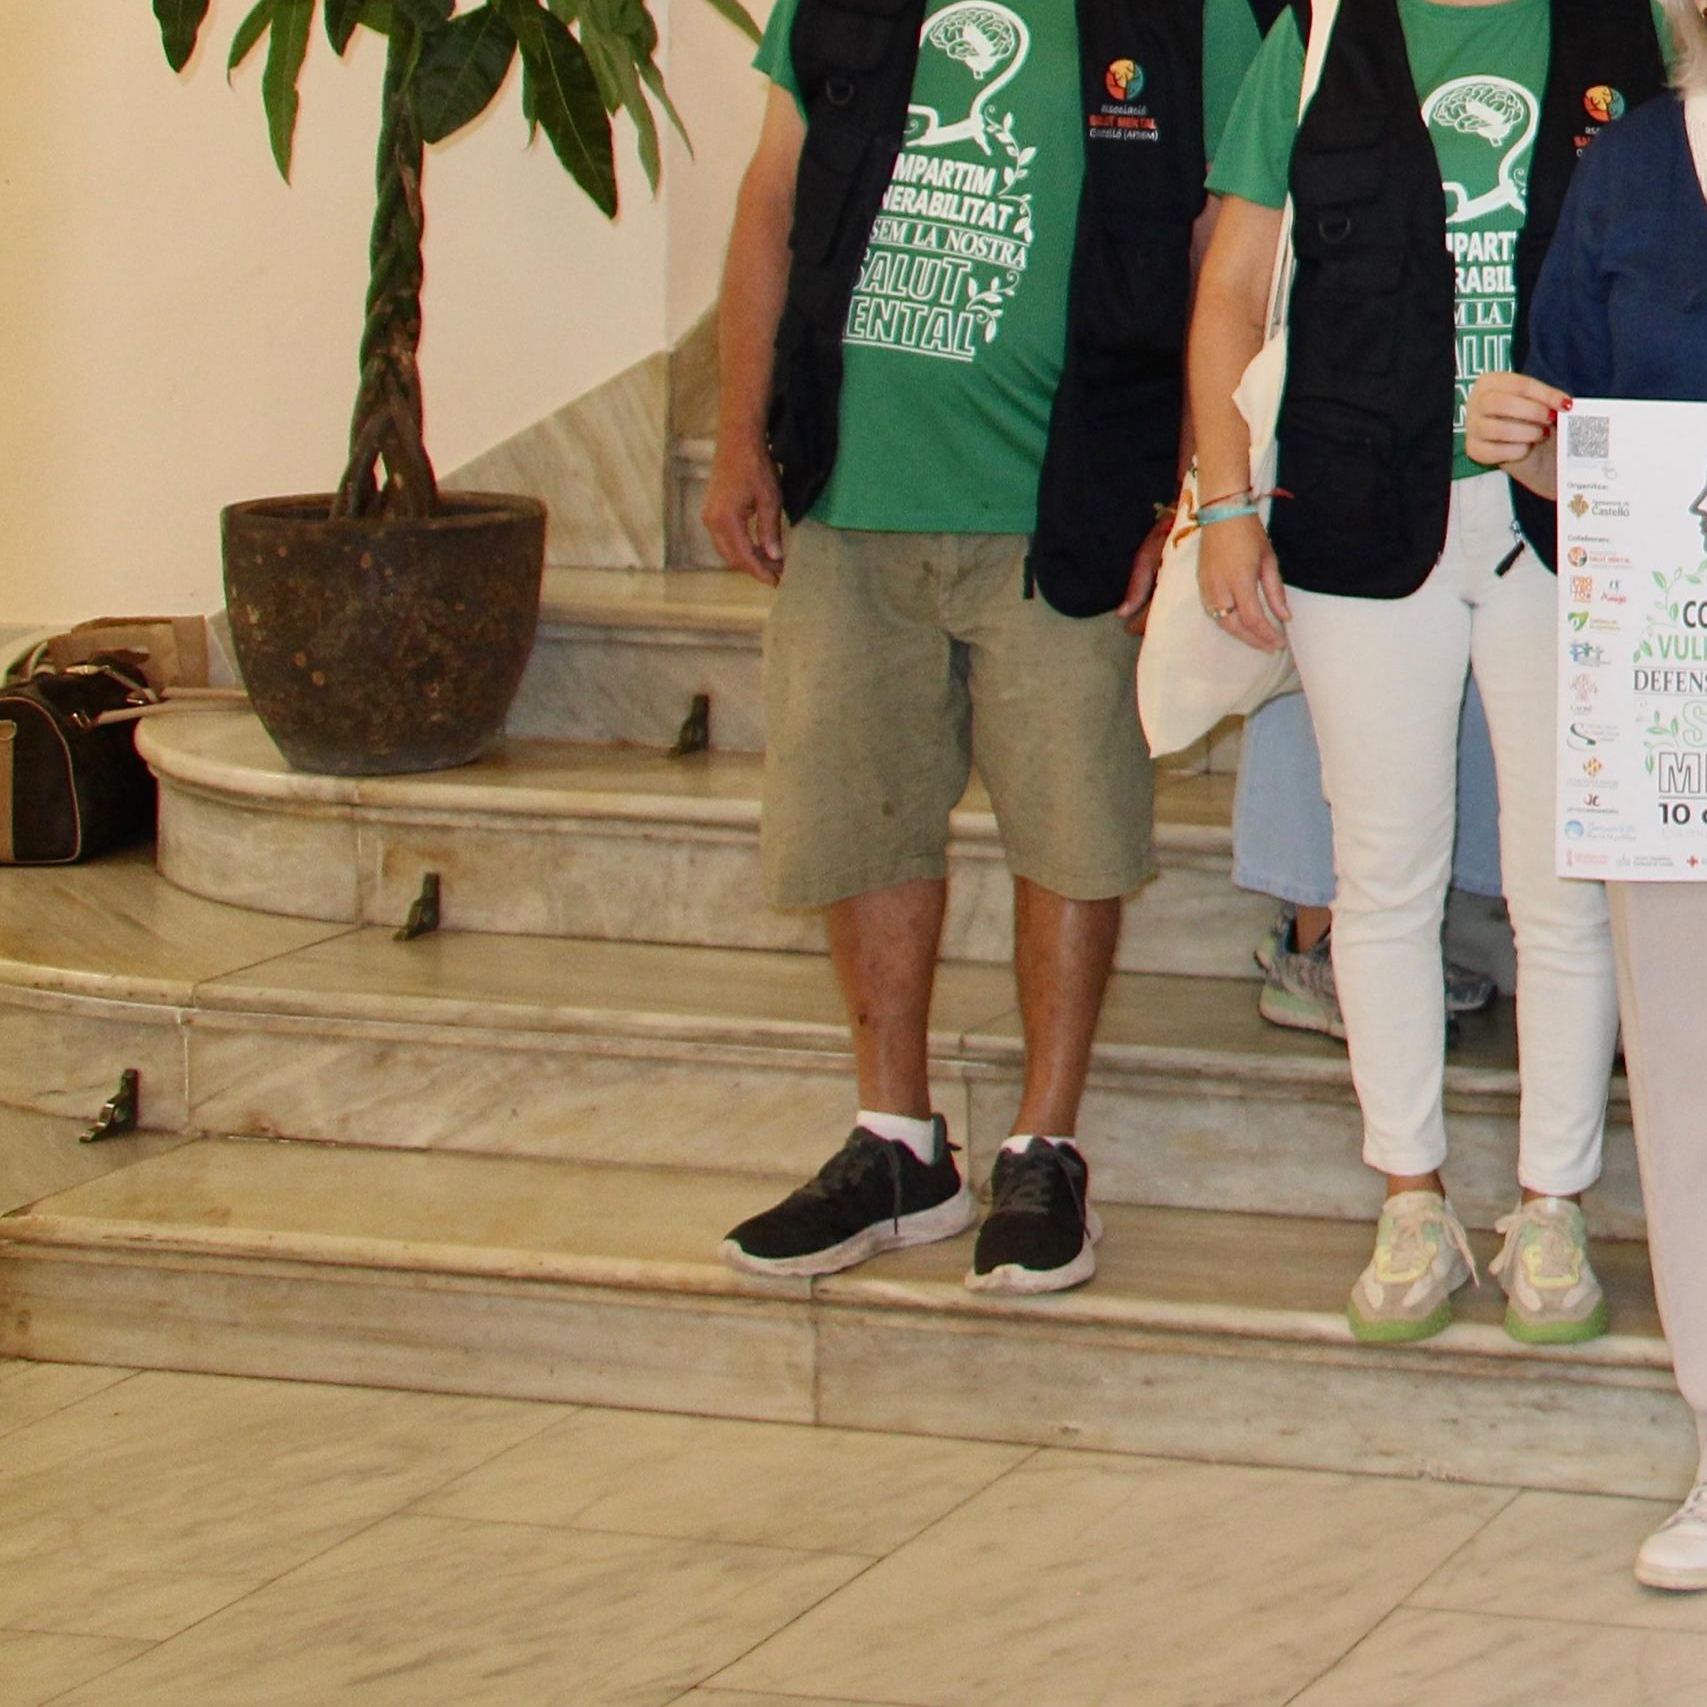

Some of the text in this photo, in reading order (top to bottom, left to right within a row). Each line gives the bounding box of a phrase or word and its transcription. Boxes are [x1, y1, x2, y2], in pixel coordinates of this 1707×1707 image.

[913, 224, 938, 250] LA
[944, 229, 1028, 270] NOSTRA
[1658, 803, 1691, 825] 10
